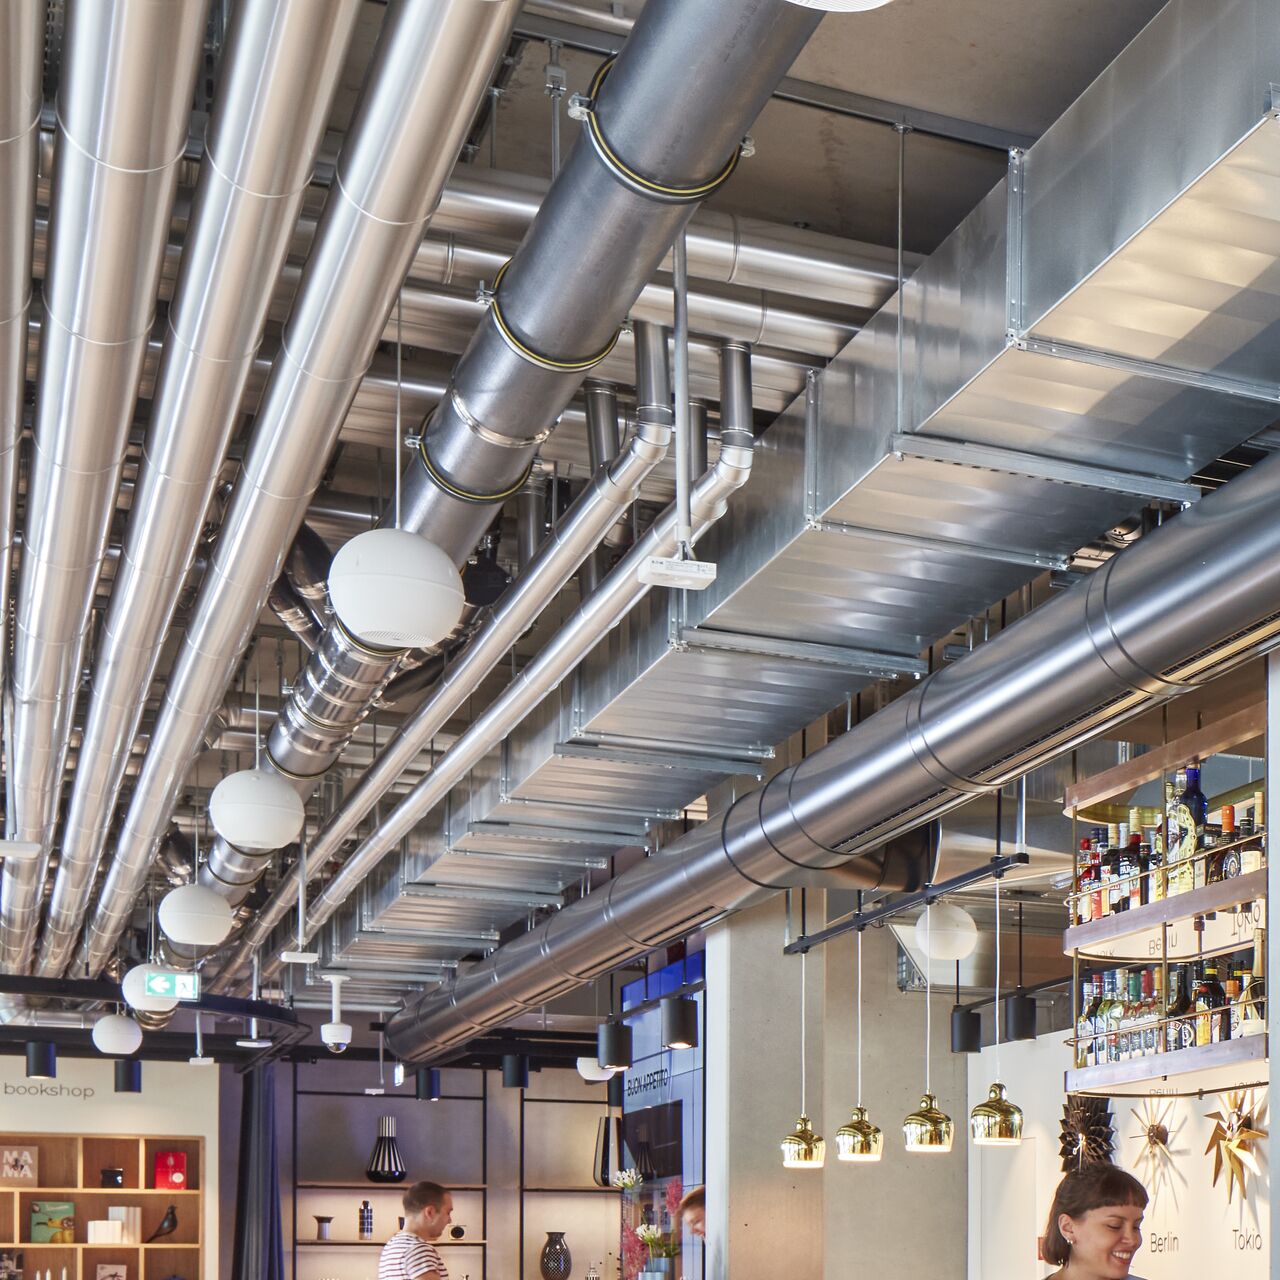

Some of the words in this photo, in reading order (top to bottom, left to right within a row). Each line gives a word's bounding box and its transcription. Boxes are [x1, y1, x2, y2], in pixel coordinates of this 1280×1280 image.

[4, 1083, 95, 1100] bookshop
[627, 1076, 642, 1097] BUON
[642, 1068, 668, 1093] APPETITO
[1150, 1231, 1180, 1253] Berlin
[1232, 1227, 1262, 1250] Tokio
